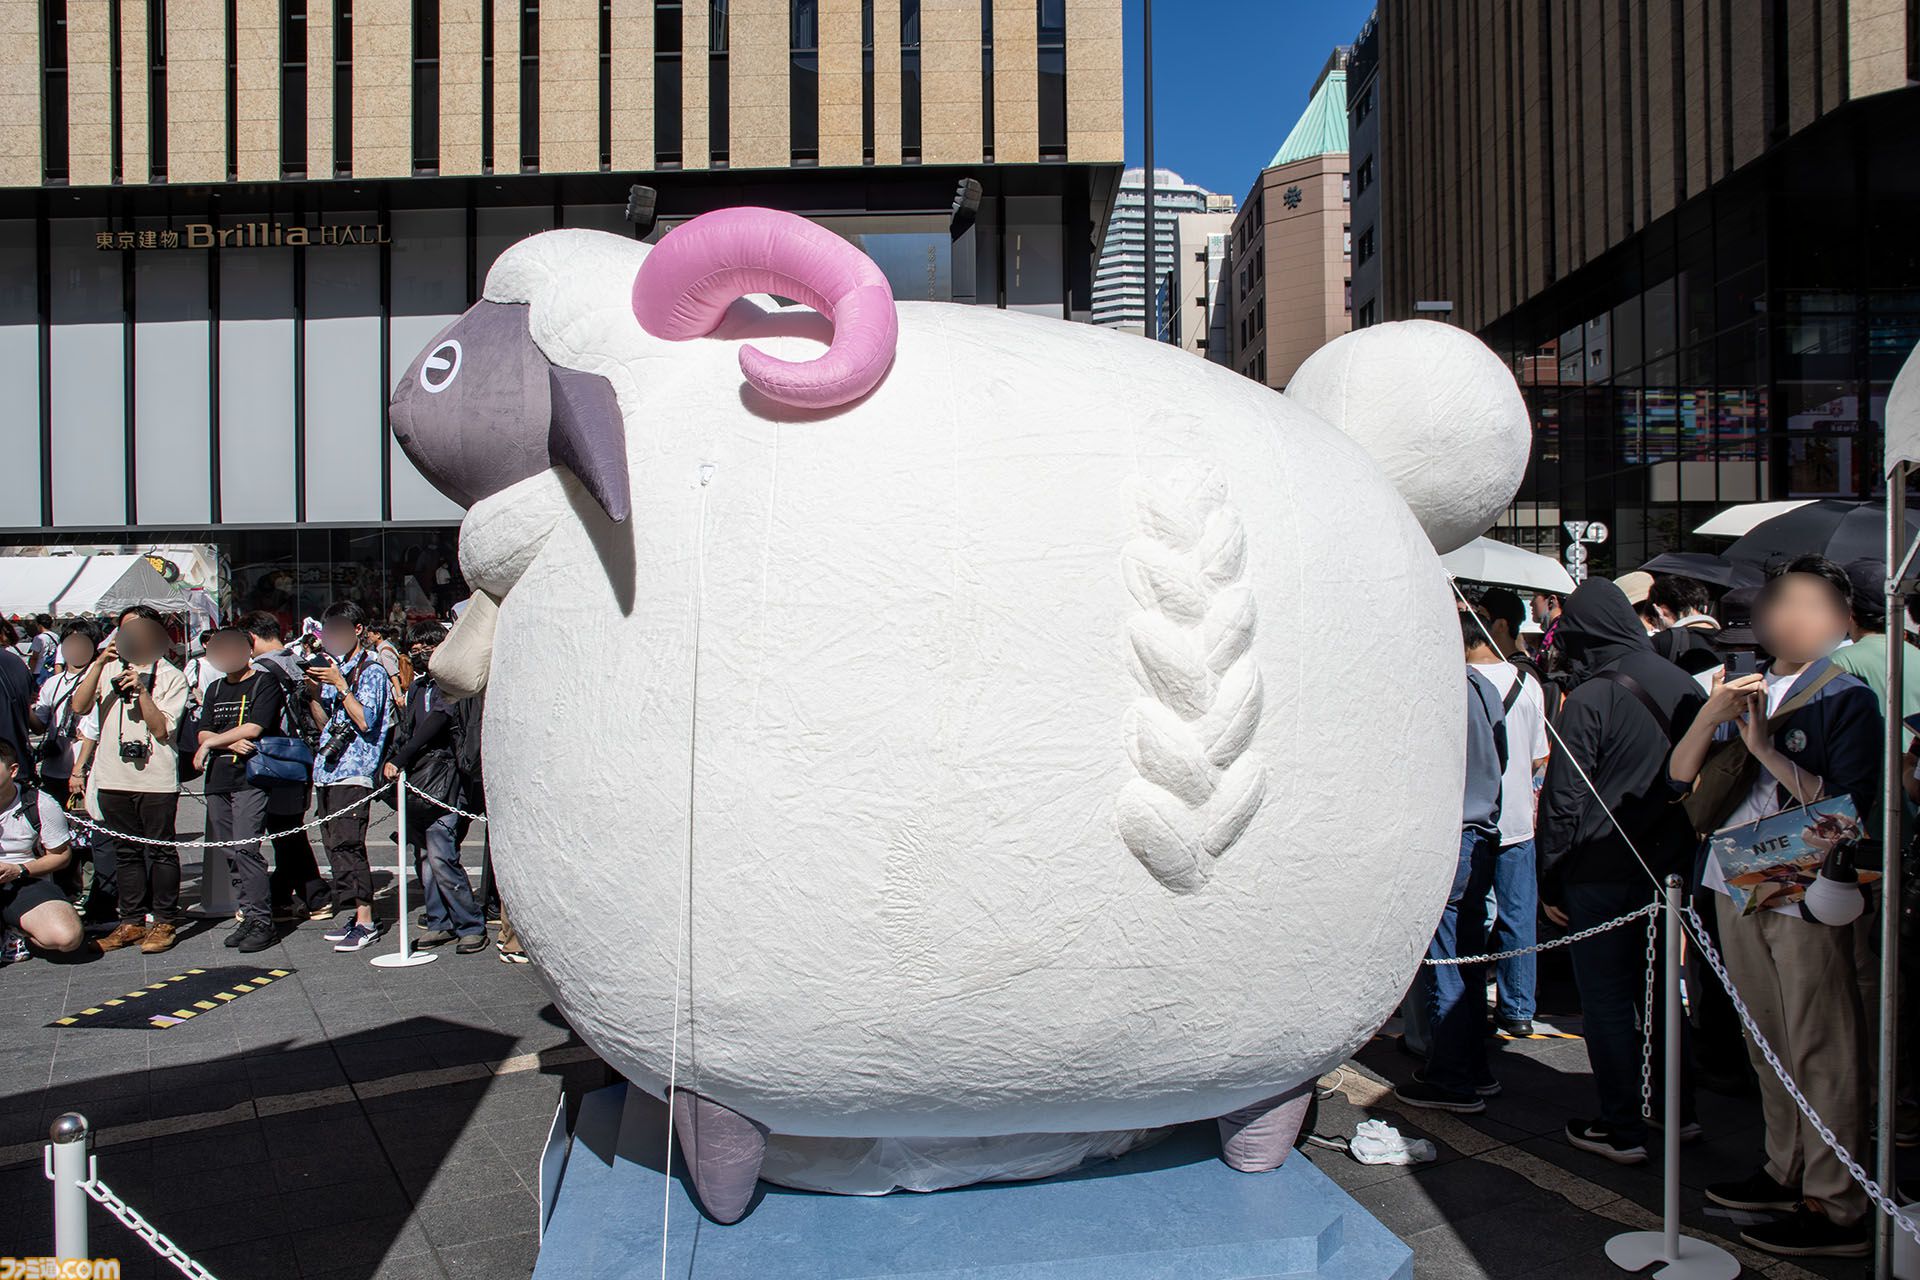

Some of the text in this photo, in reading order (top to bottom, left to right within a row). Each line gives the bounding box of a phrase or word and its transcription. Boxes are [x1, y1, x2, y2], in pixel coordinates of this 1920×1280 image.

[96, 223, 391, 249] 東京建物 Brillia HALL
[1752, 835, 1790, 856] NTE
